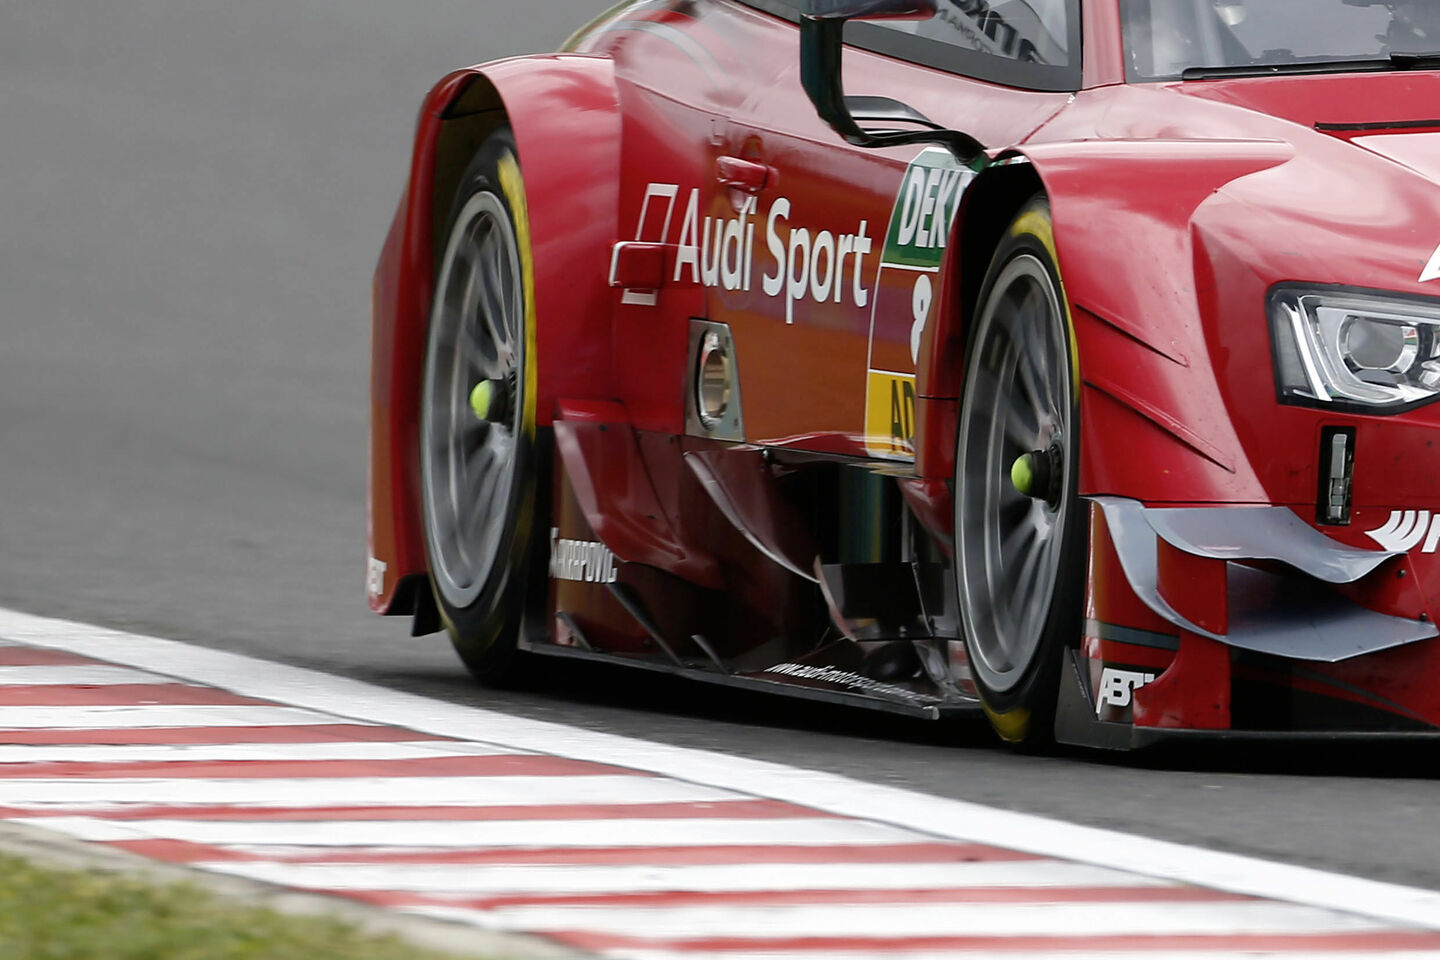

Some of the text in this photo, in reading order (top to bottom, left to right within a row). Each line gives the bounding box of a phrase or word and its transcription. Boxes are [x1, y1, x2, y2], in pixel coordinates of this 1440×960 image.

[673, 187, 872, 325] Audi Sport
[910, 273, 932, 366] 8
[890, 378, 916, 452] AD
